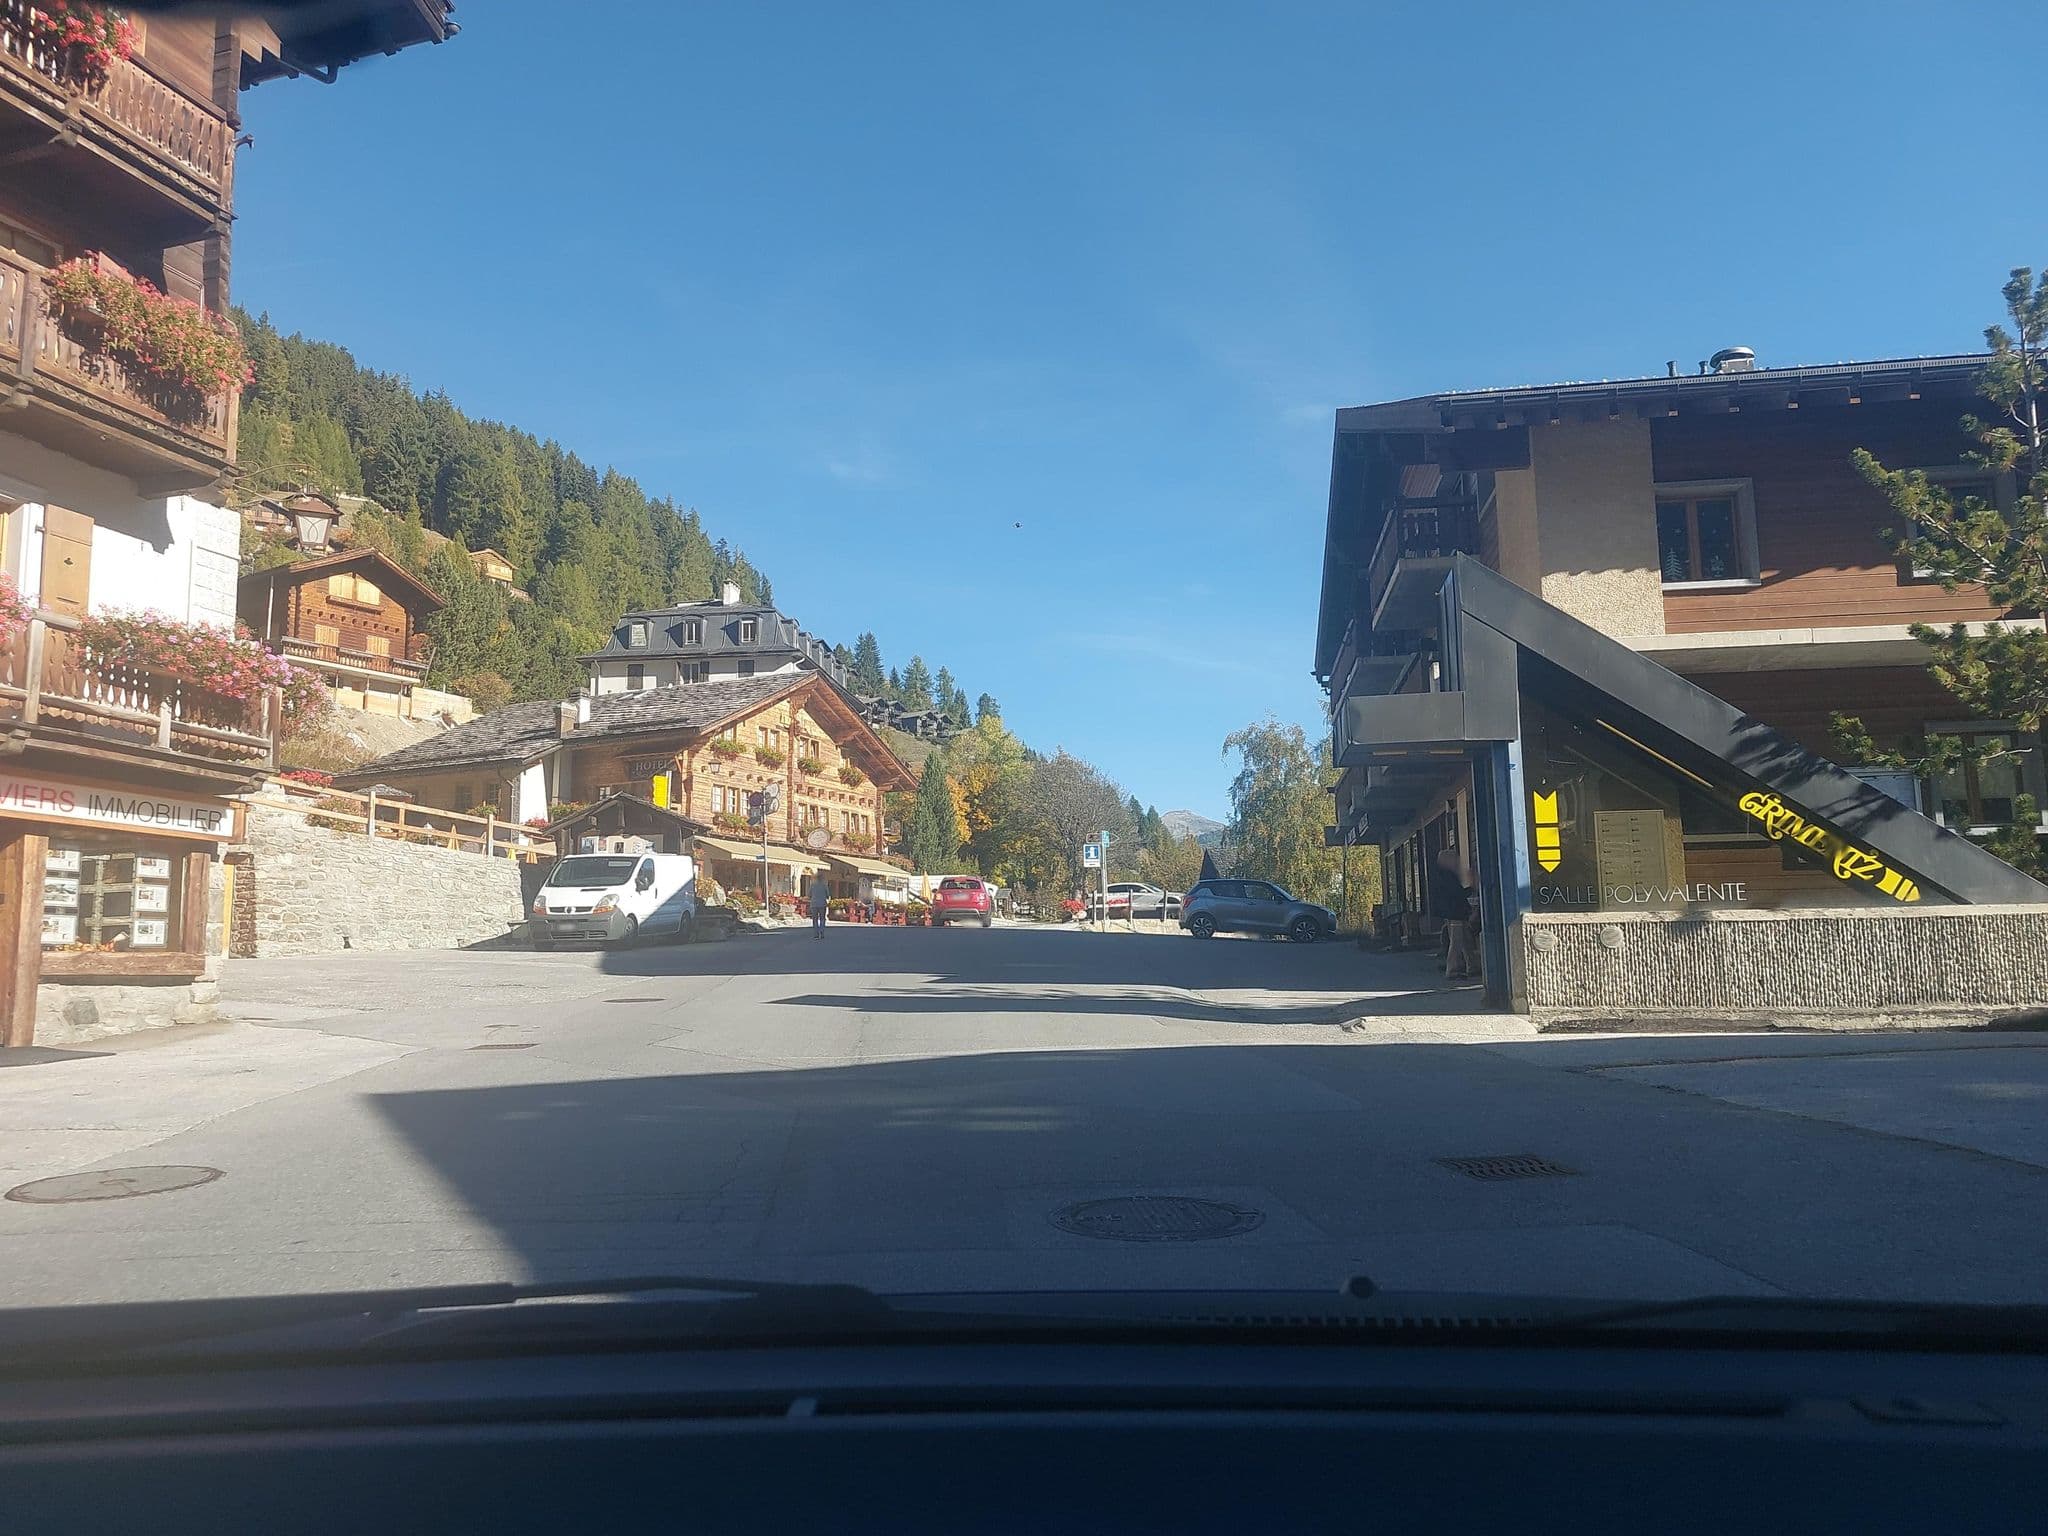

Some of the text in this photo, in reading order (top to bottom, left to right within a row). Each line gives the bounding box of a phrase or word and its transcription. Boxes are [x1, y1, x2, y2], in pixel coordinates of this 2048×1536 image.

[88, 794, 223, 832] IMMOBILIER
[1539, 882, 1748, 905] SALLE POLYVALENTE
